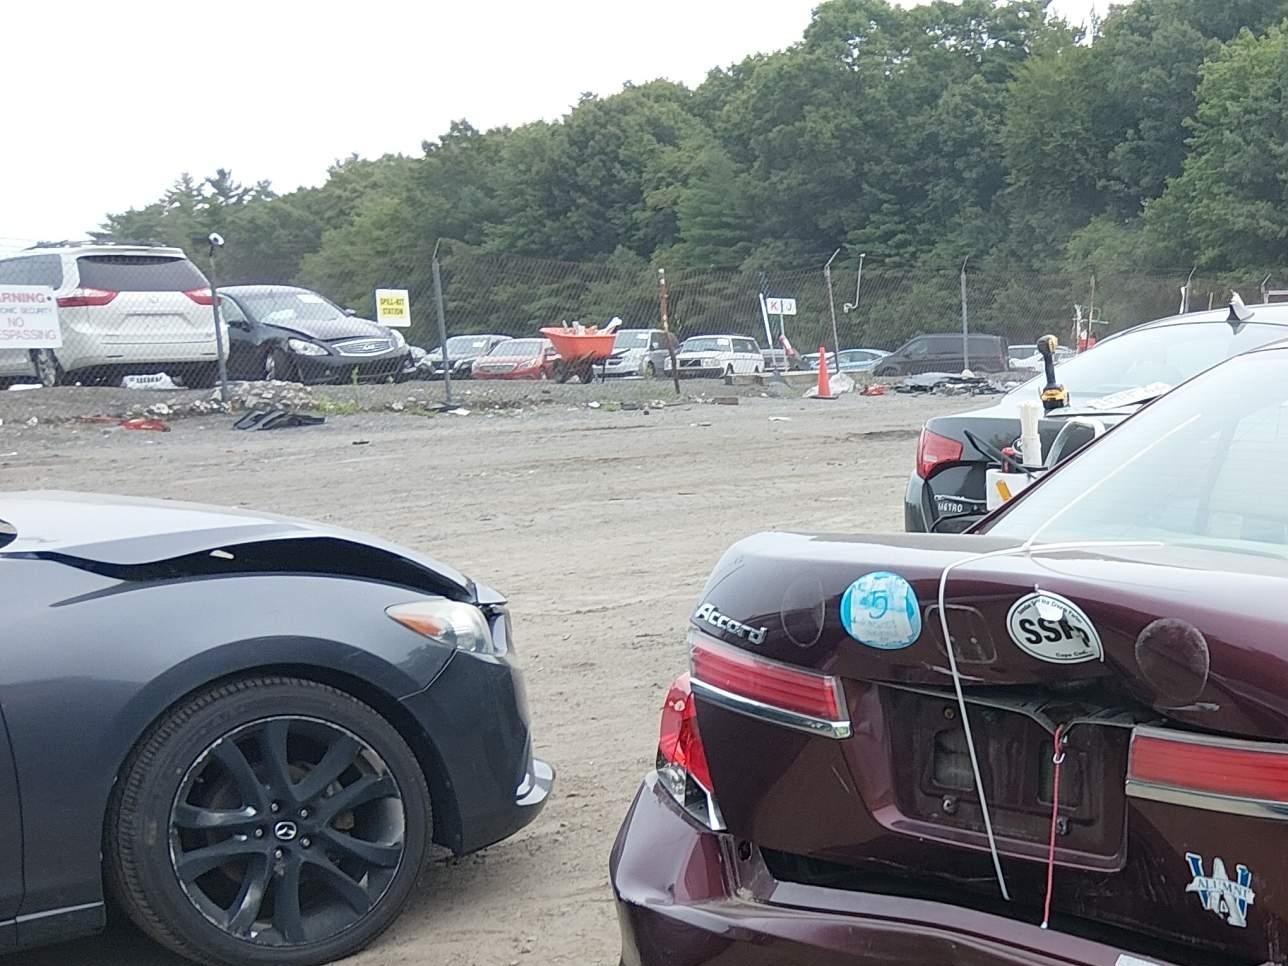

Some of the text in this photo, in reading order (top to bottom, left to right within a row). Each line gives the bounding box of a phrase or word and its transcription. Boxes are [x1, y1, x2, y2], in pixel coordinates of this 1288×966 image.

[0, 292, 45, 303] RNING
[383, 307, 403, 315] STATION
[770, 301, 779, 311] K
[7, 316, 25, 327] NO
[0, 329, 56, 340] SPASSING
[938, 503, 963, 513] METRO
[695, 603, 768, 645] Accord
[1198, 877, 1248, 899] ALUMNI
